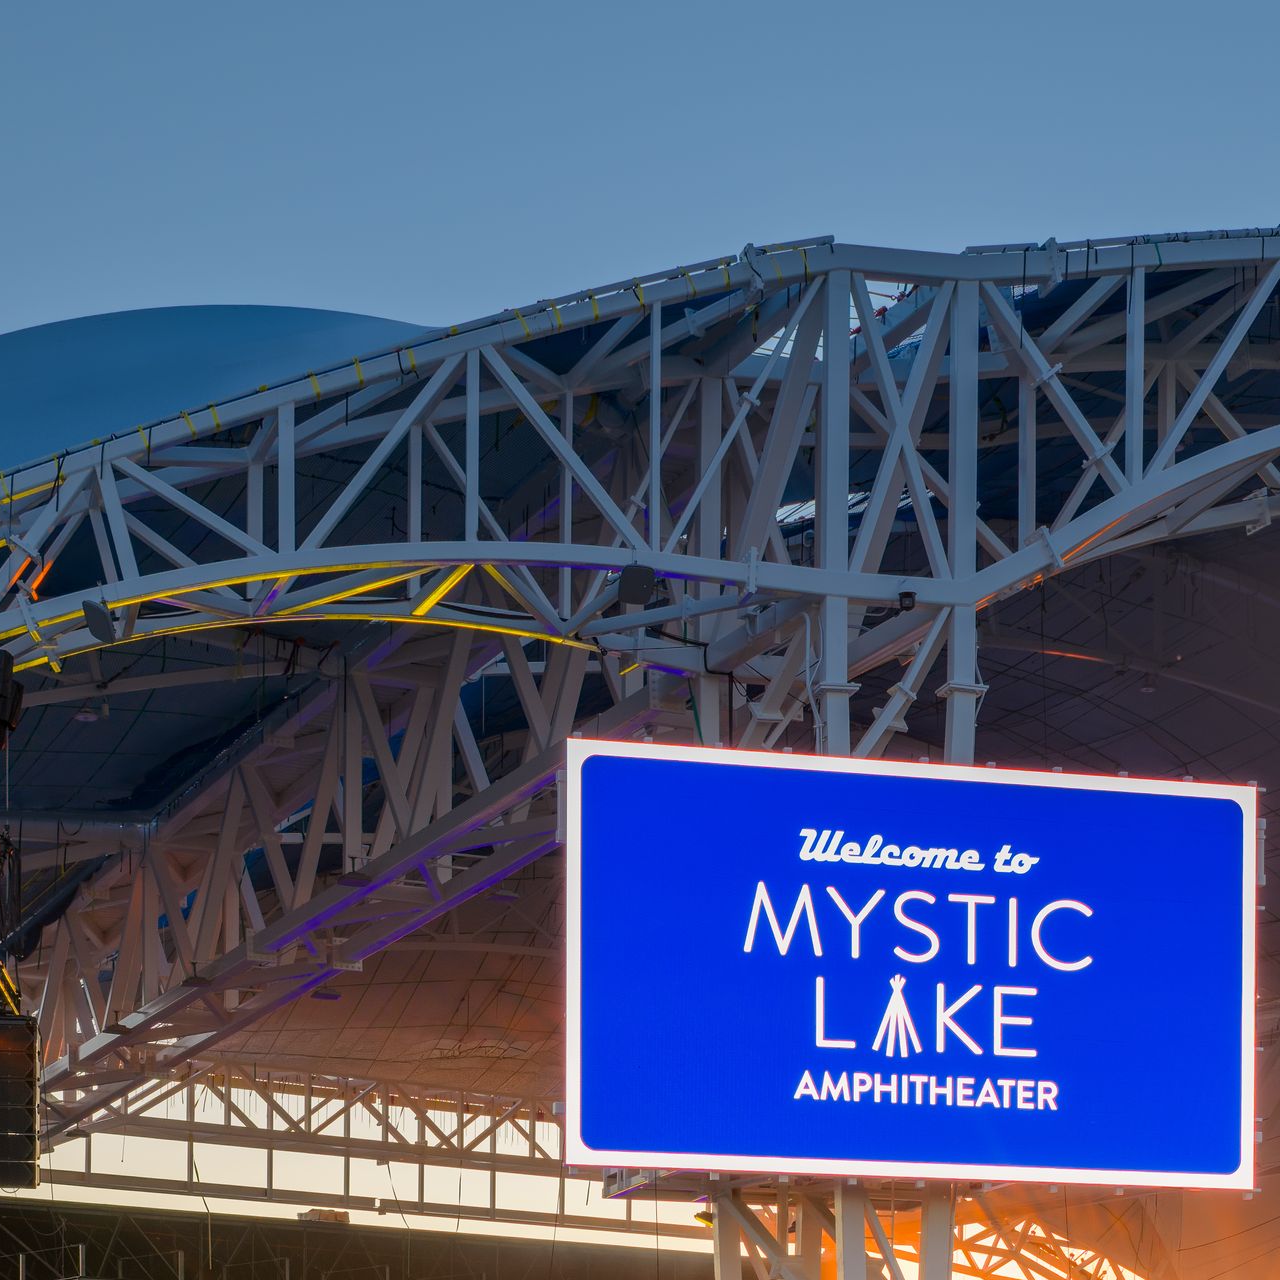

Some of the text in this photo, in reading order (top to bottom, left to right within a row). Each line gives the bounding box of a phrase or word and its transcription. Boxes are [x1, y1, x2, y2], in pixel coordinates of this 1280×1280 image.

[799, 828, 1040, 875] Welcome to
[743, 880, 1094, 972] MYSTIC
[815, 974, 1038, 1058] LAKE
[793, 1069, 1059, 1111] AMPHITHEATER
